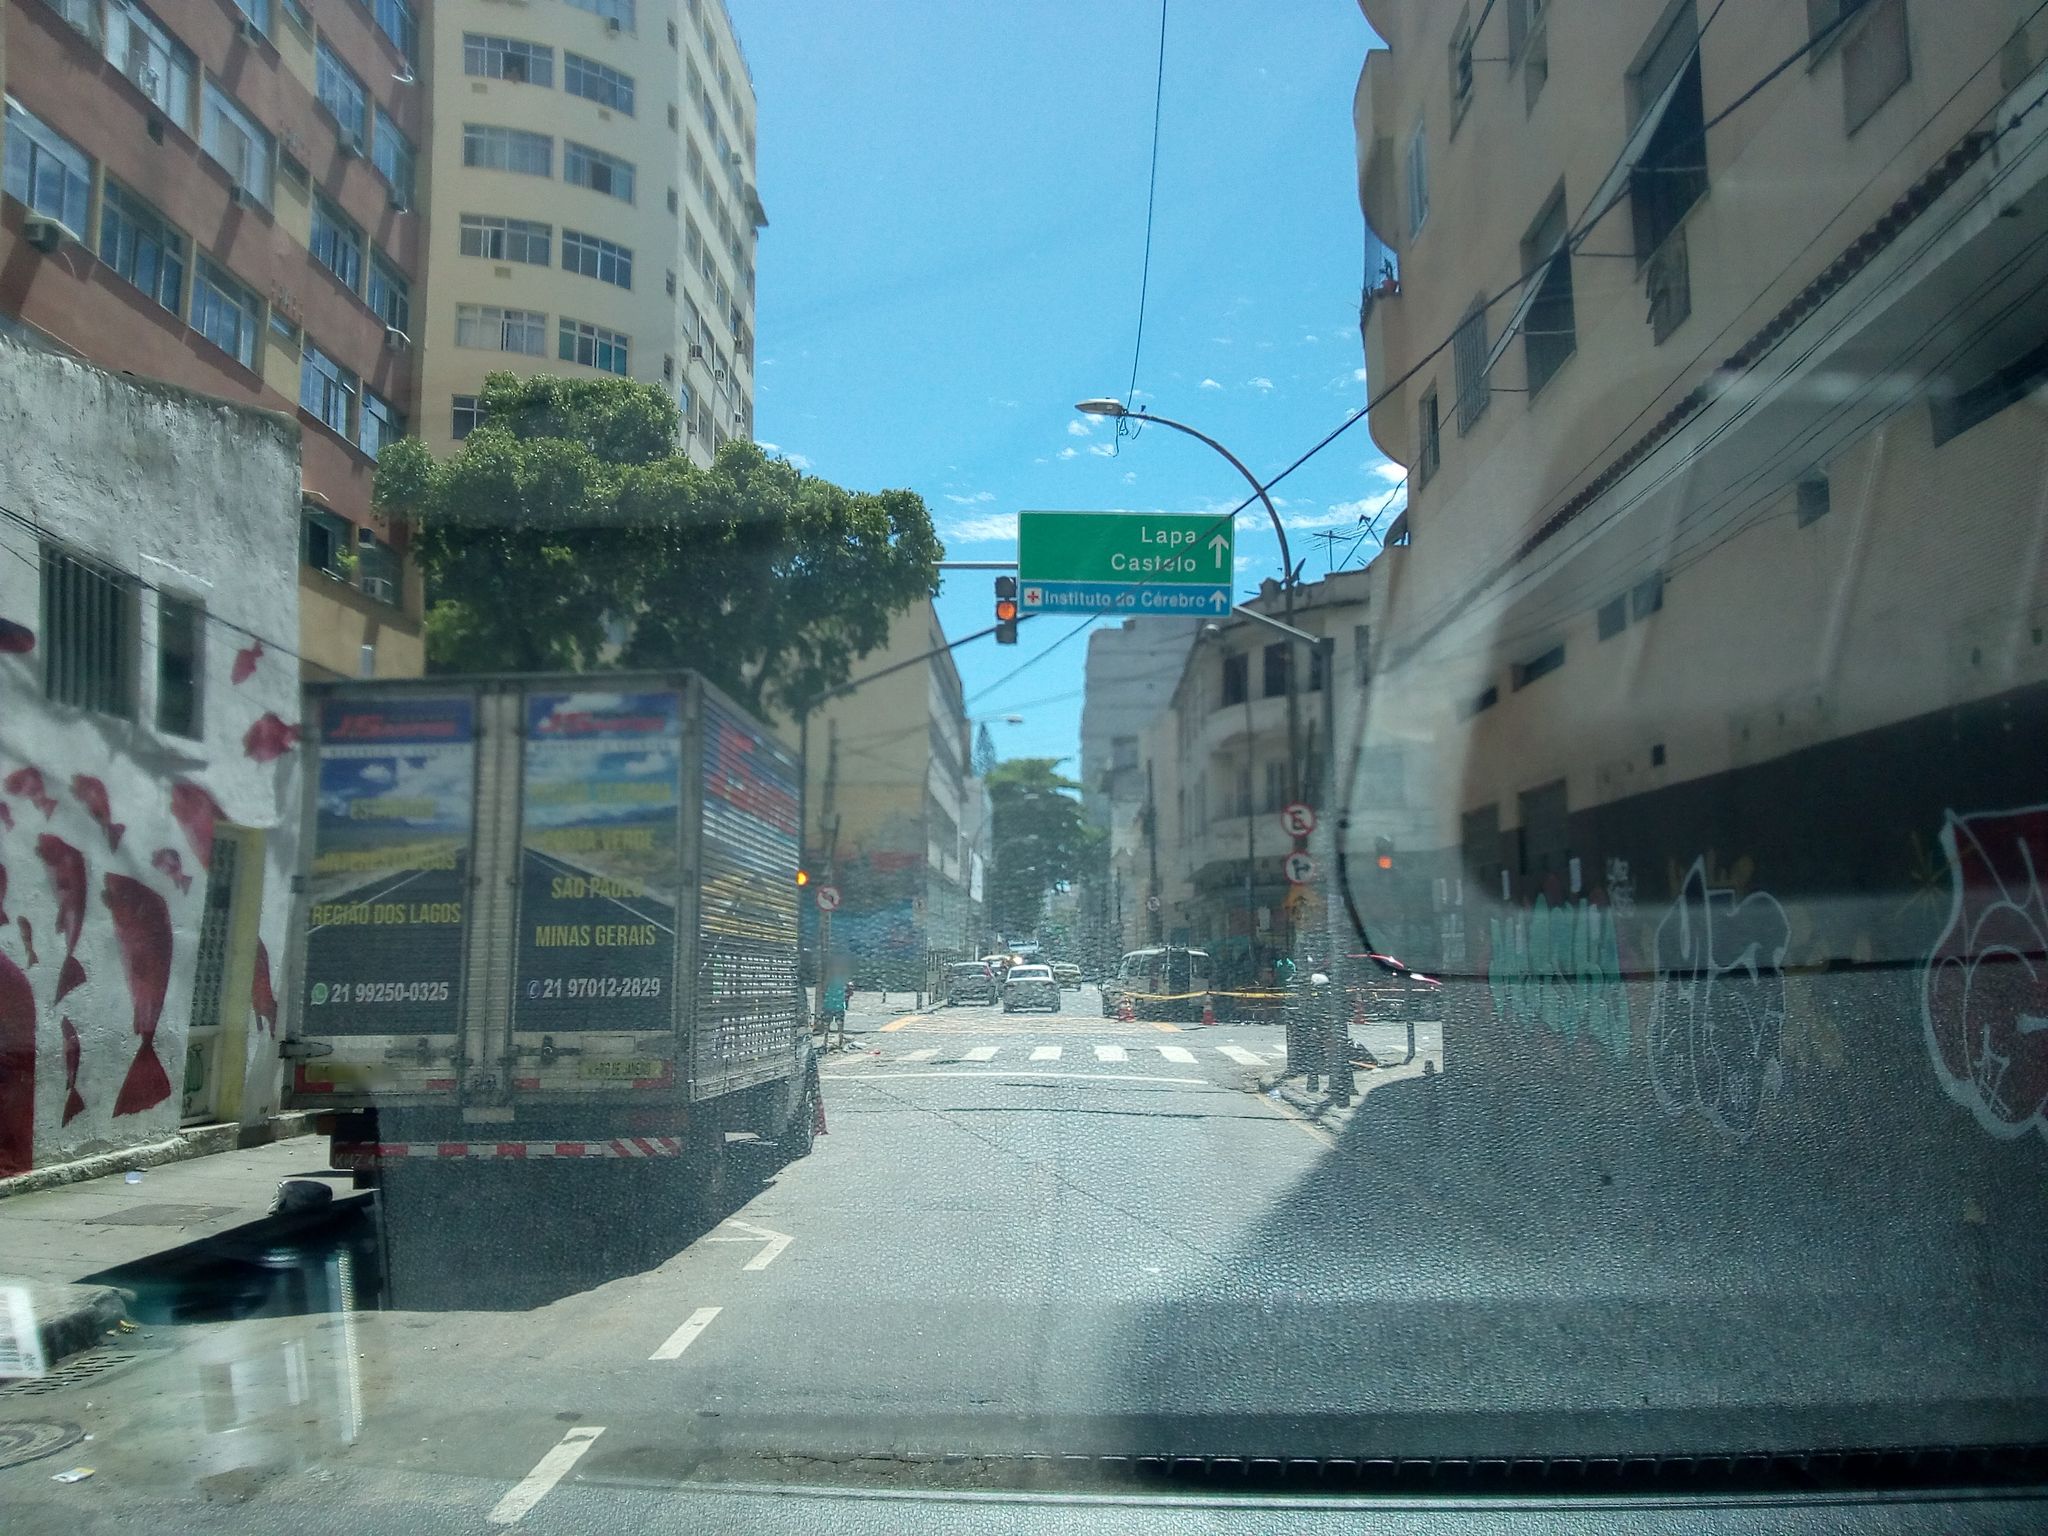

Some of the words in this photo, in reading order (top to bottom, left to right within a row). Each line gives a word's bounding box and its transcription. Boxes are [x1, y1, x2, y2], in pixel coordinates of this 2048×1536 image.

[1141, 526, 1196, 548] Lapa
[1111, 553, 1196, 572] Castelo
[1045, 590, 1111, 606] Instituto
[1115, 592, 1135, 607] do
[1141, 591, 1205, 608] Cérebro
[590, 876, 643, 898] PAULO
[312, 901, 369, 925] REGIÃO
[374, 903, 407, 924] DOS
[410, 902, 461, 924] LAGOS
[535, 925, 590, 946] MINAS
[595, 924, 656, 946] GERAIS
[330, 983, 350, 1003] 21
[355, 982, 449, 1002] 99250-0325
[543, 978, 562, 998] 21
[568, 977, 661, 997] 97012-2829
